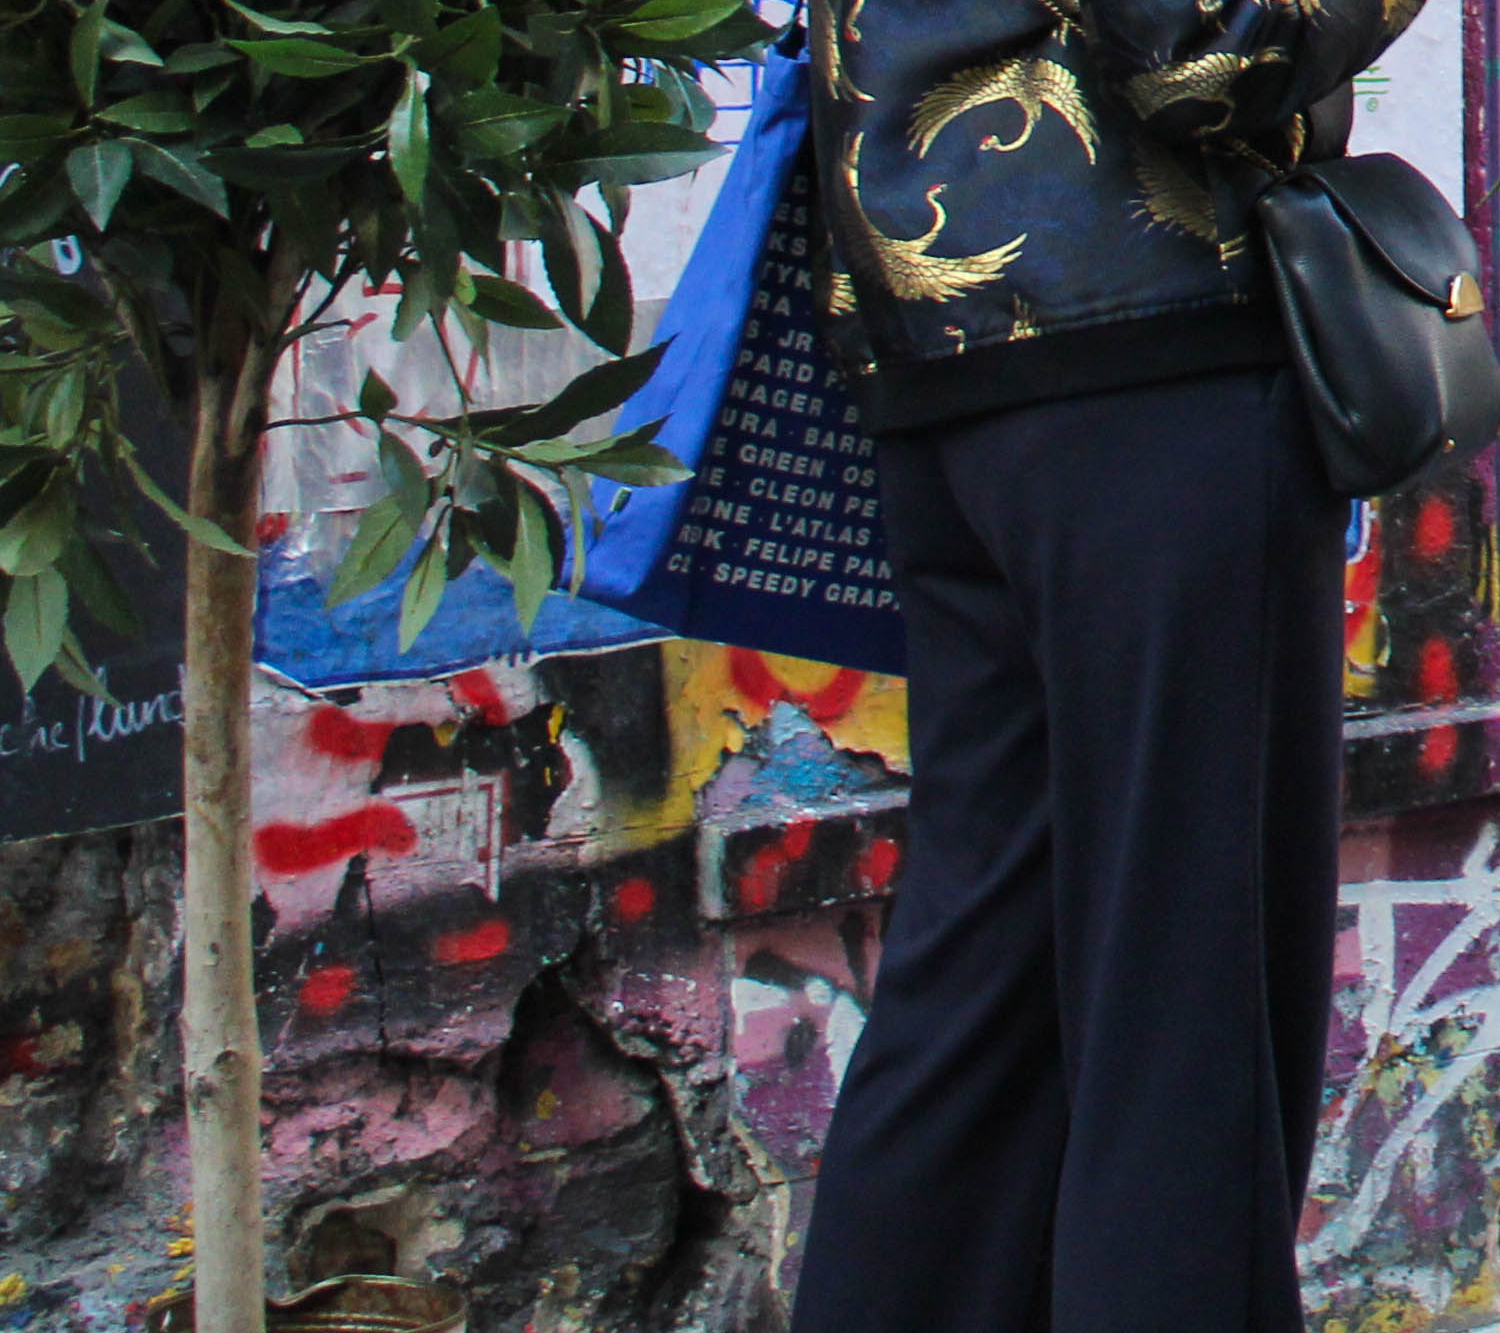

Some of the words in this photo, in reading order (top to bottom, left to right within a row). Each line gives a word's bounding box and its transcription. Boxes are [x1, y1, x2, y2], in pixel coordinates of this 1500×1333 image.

[778, 328, 814, 353] JR
[730, 378, 825, 417] NAGER
[738, 443, 826, 479] GREEN
[769, 512, 873, 547] L'ATLAS
[744, 537, 836, 571] FELIPE
[712, 563, 817, 598] SPEEDY
[824, 583, 901, 610] GRAP
